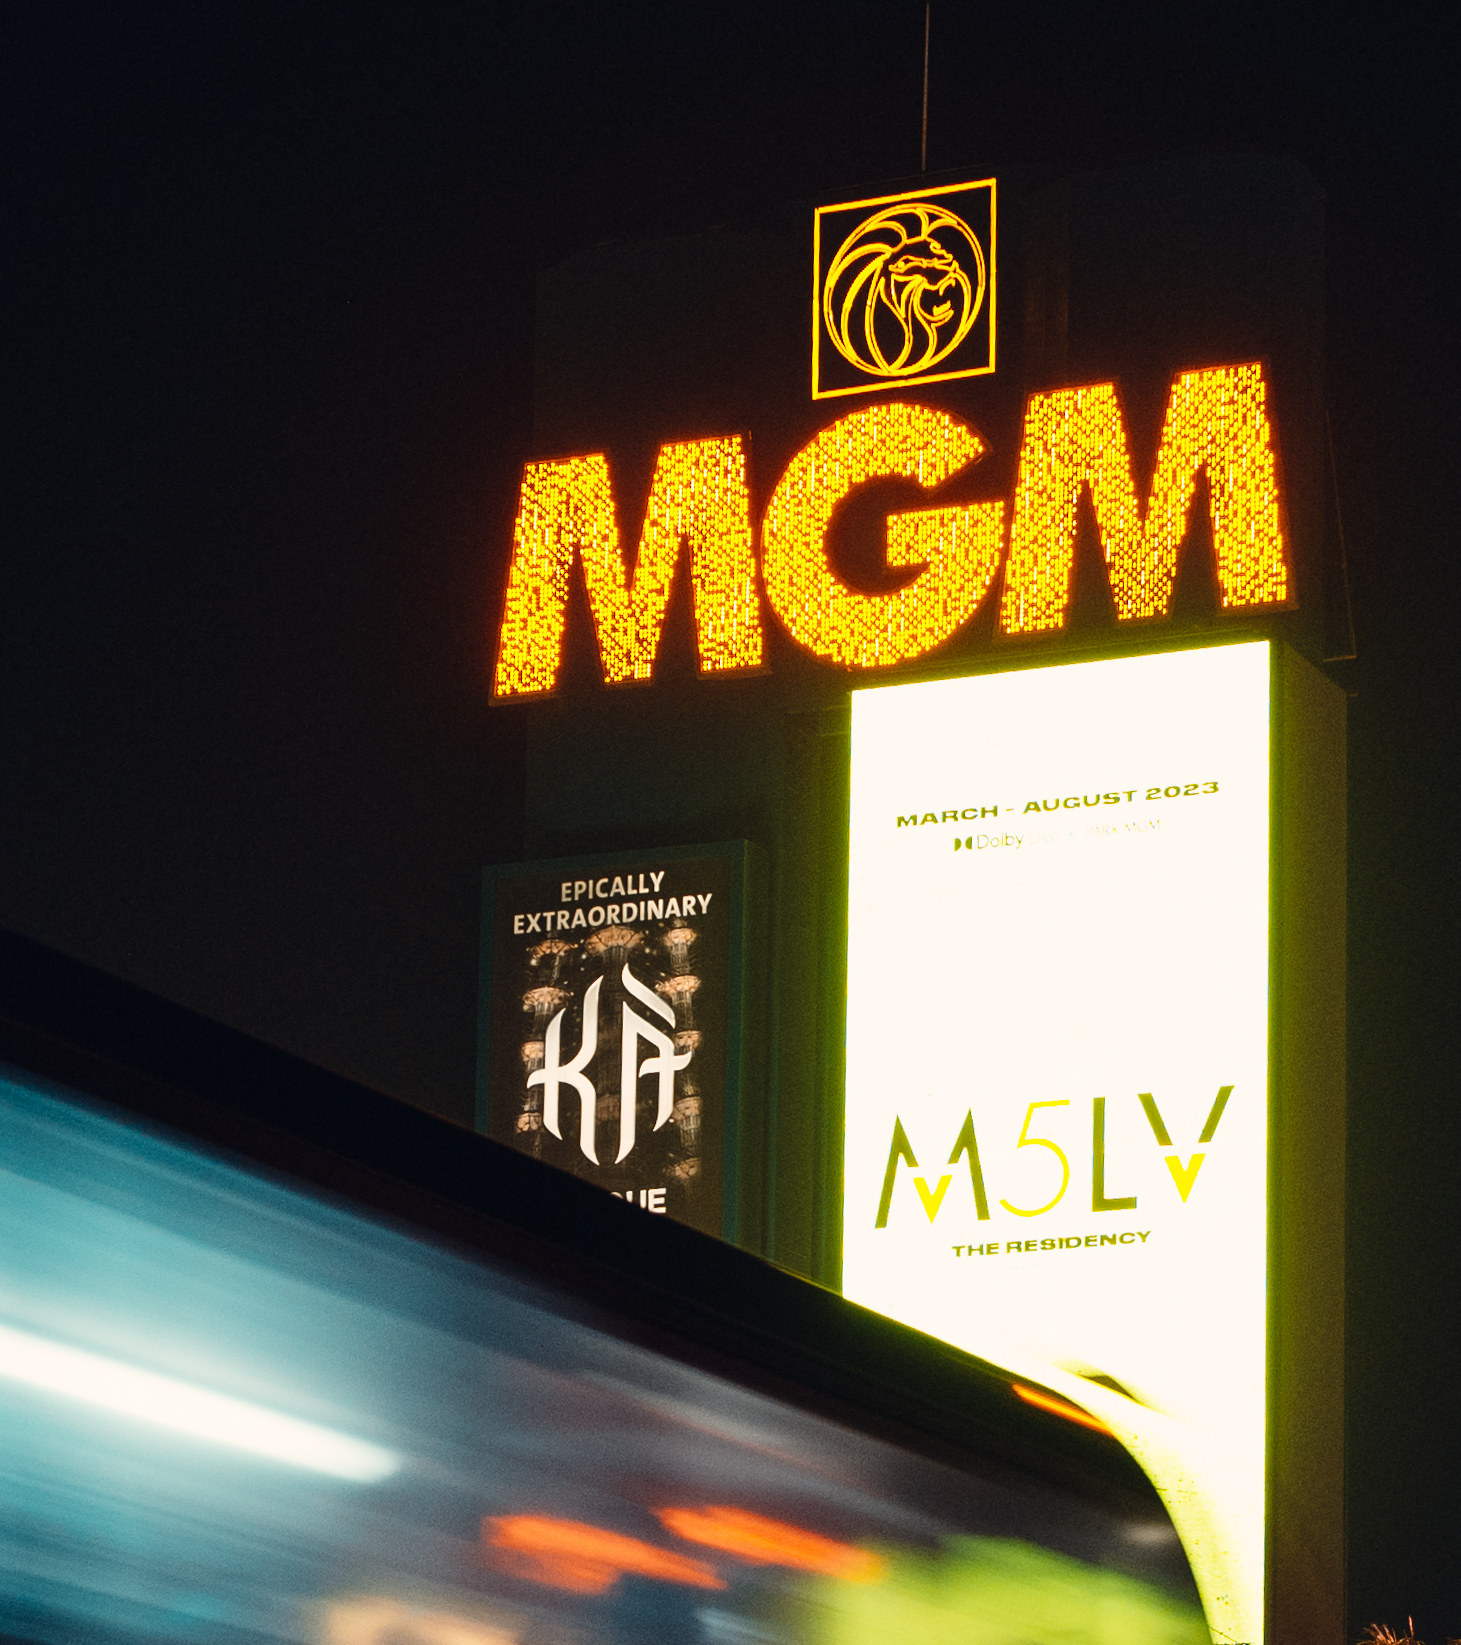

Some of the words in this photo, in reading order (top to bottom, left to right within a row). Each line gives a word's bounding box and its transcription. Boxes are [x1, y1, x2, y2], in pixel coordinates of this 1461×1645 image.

[492, 359, 1294, 703] MGM
[895, 804, 999, 829] MARCH
[1021, 788, 1139, 816] AUGUST
[1144, 780, 1221, 802] 2023
[975, 831, 1026, 852] Dolby
[560, 870, 666, 903] EPICALLY
[513, 892, 714, 935] EXTRAORDINARY
[874, 1084, 1236, 1230] M5LV
[951, 1242, 1001, 1259] THE
[1005, 1229, 1153, 1255] RESIDENCY
